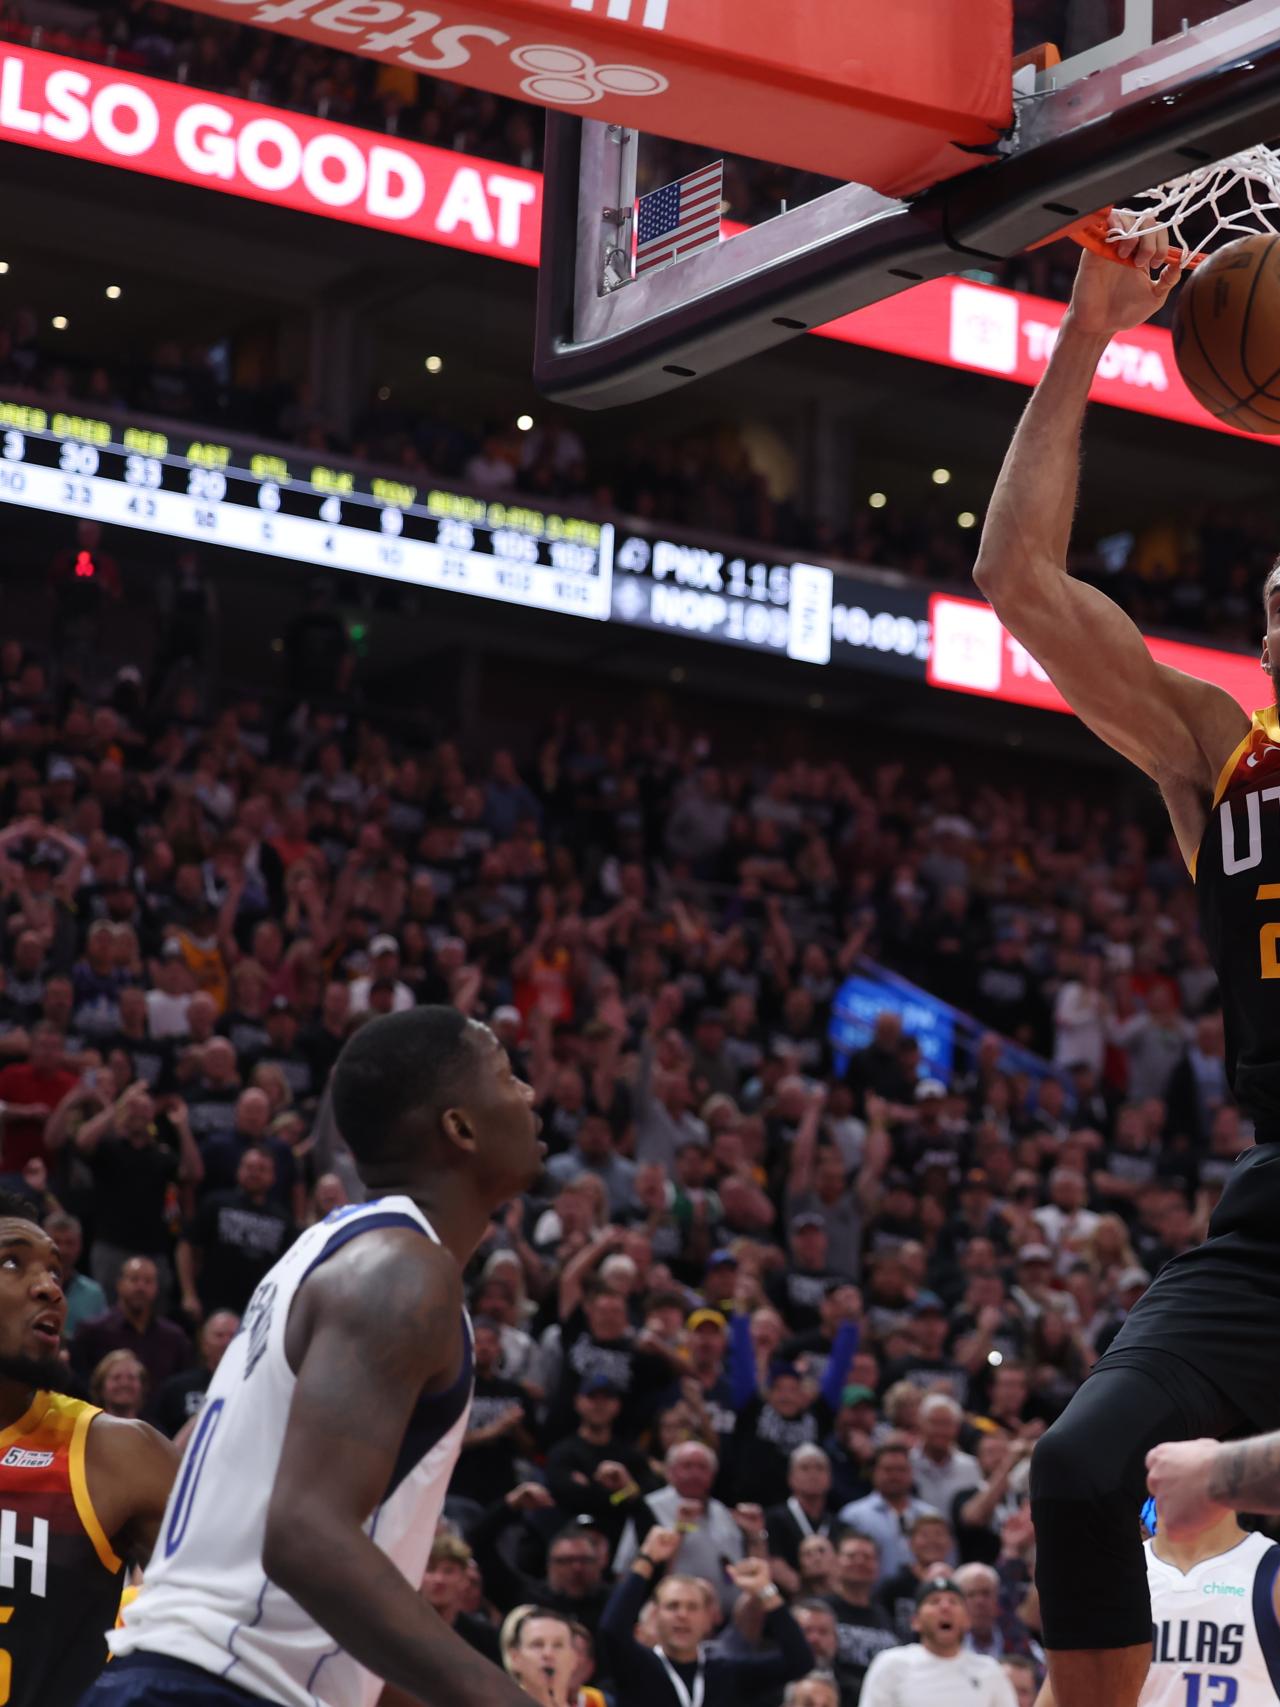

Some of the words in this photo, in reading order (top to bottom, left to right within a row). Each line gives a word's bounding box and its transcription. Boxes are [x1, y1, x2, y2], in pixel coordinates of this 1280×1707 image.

[222, 0, 510, 69] Stat
[174, 103, 426, 220] GOOD
[436, 168, 535, 247] AT
[1022, 320, 1168, 392] TOTA
[5, 1449, 21, 1465] 5
[1203, 1582, 1246, 1597] chime
